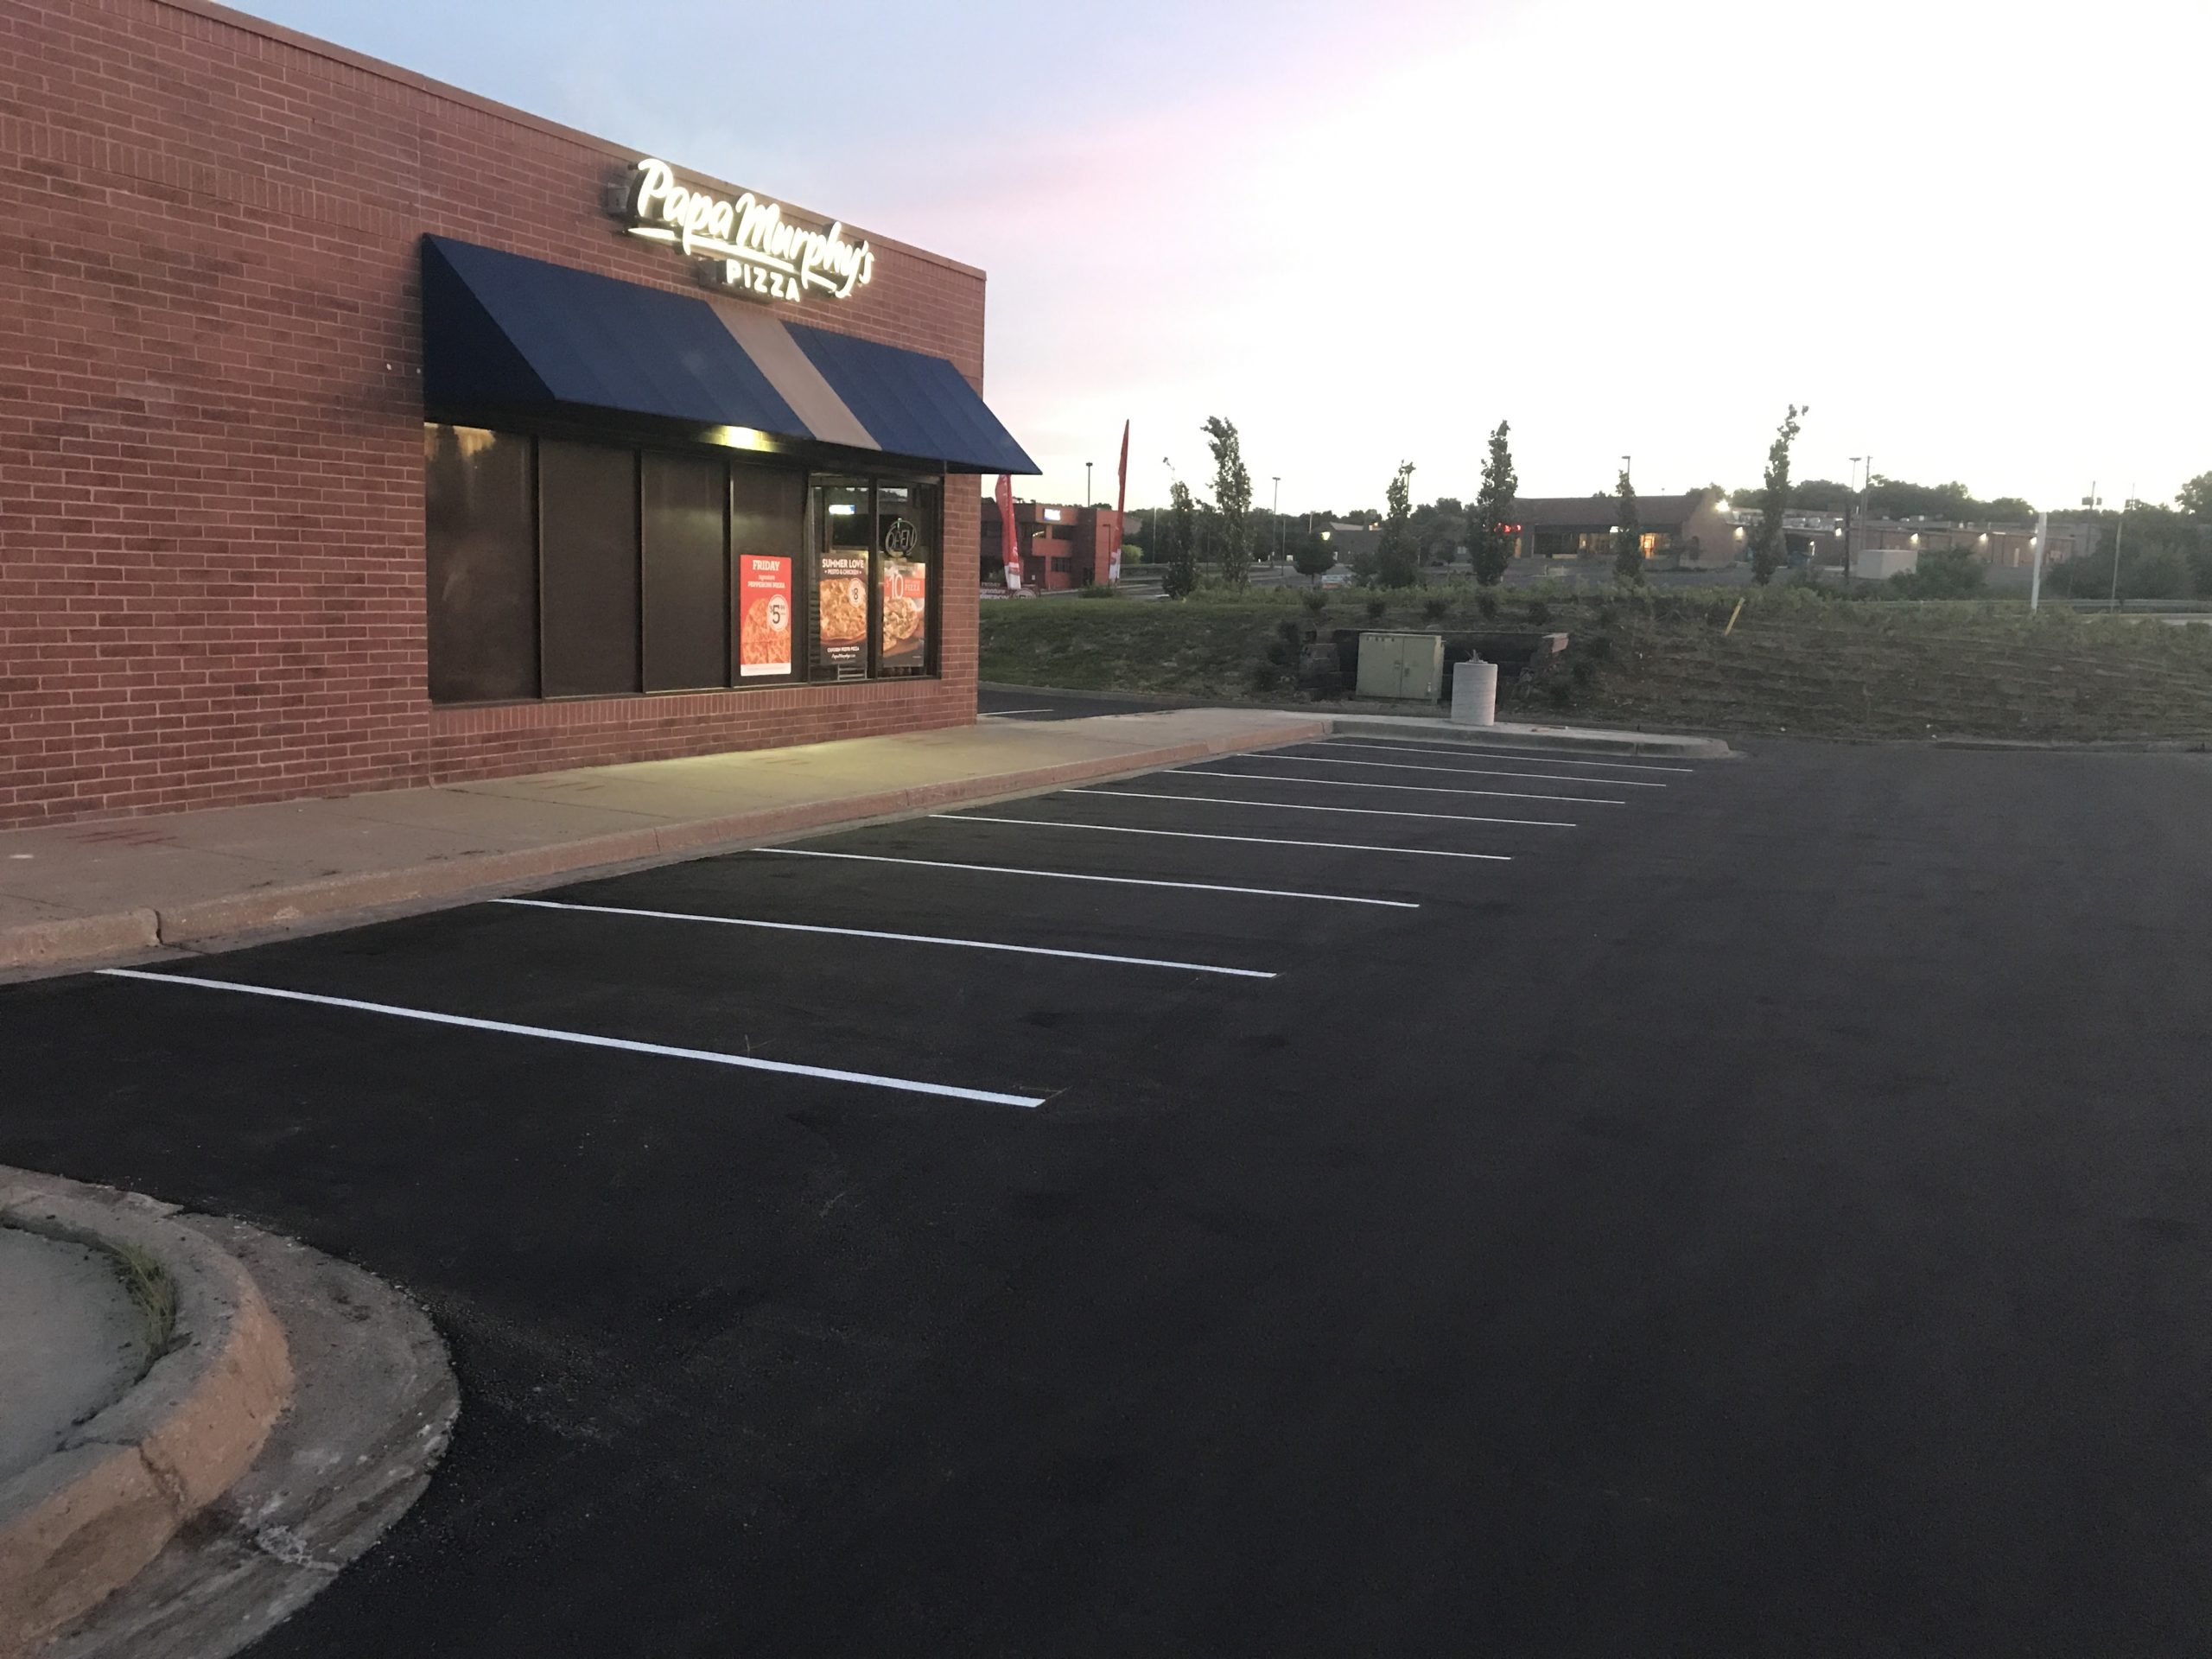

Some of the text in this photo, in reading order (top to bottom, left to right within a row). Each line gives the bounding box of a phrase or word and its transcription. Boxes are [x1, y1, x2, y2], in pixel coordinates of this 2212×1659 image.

[637, 158, 874, 298] Papa Murphy's
[726, 258, 800, 302] PIZZA
[887, 527, 916, 549] OPEN
[752, 559, 780, 571] FRIDAY
[822, 558, 864, 569] SUMMER LOVE
